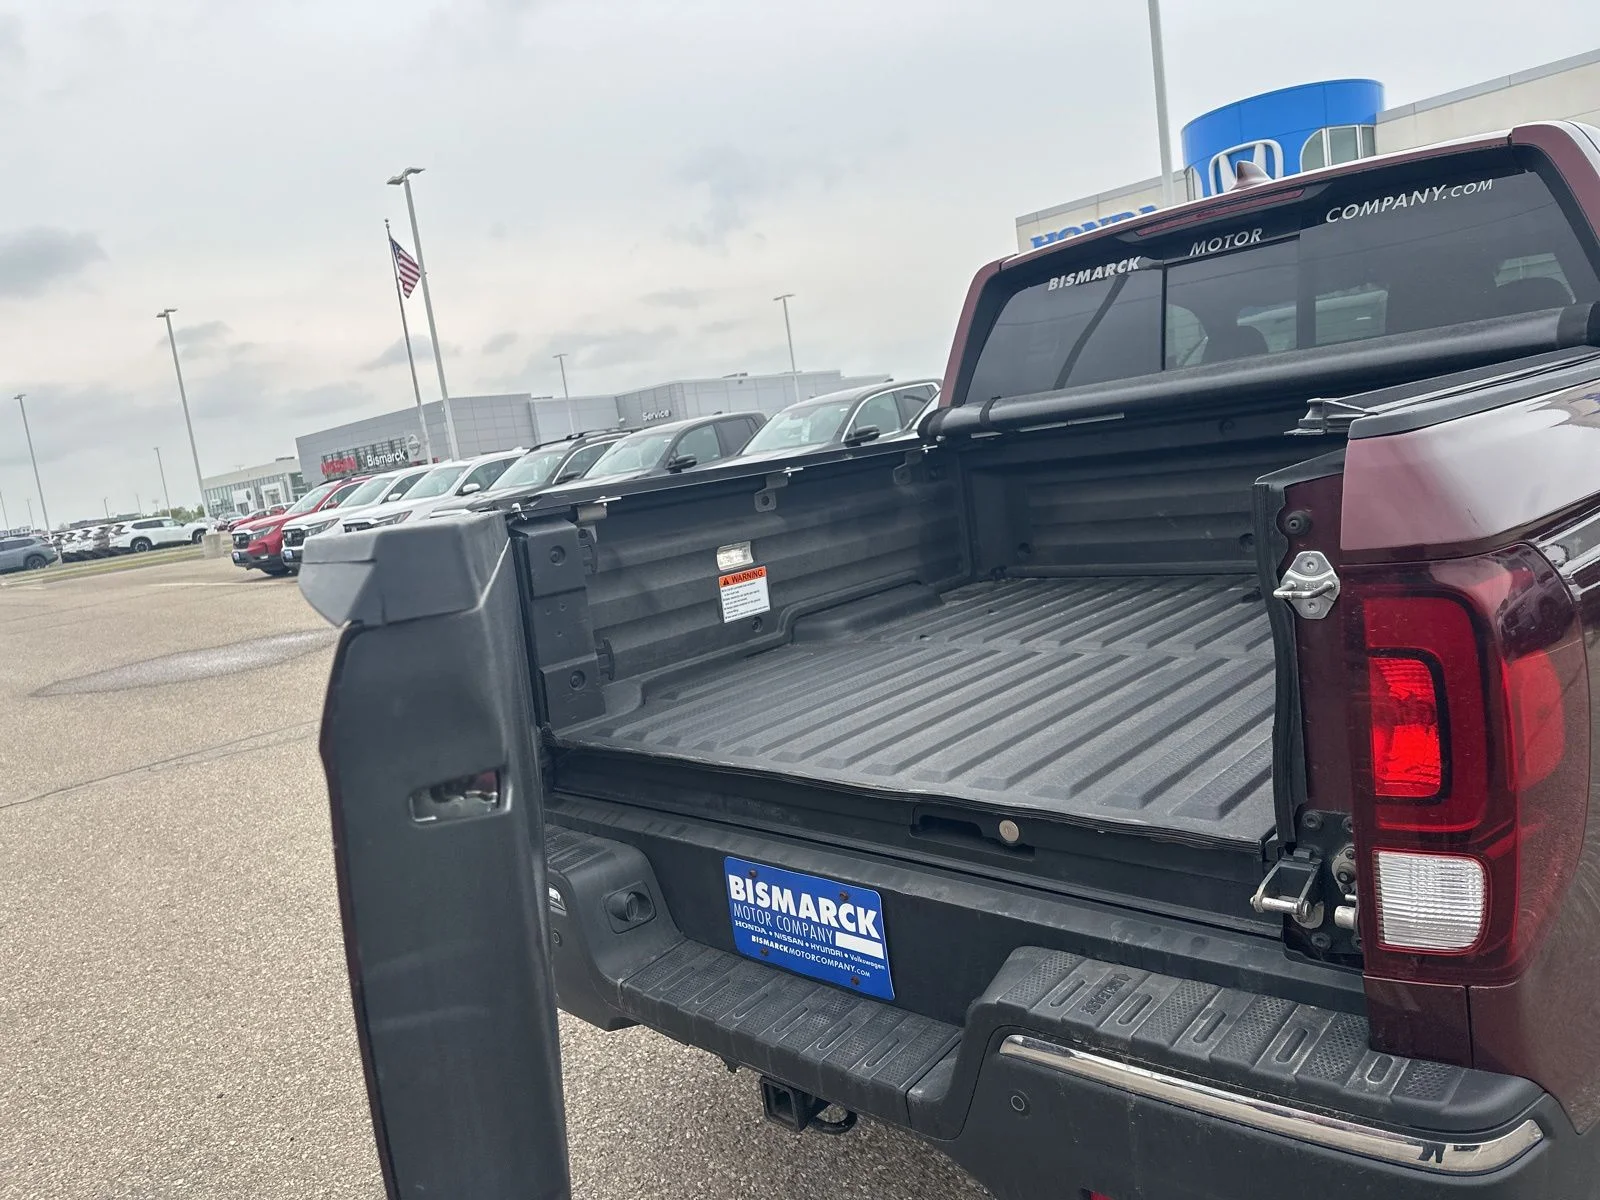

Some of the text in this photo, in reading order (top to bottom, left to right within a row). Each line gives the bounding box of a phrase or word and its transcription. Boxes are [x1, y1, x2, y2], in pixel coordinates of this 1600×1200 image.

[1048, 178, 1493, 291] BISMARCK MOTOR COMPANY.COM
[642, 409, 671, 421] Service
[366, 449, 406, 467] Bismarck
[731, 569, 763, 583] WARNING
[728, 874, 881, 939] BISMARCK
[733, 902, 833, 945] MOTOR COMPANY
[735, 919, 767, 935] HONDA
[774, 931, 804, 946] NISSAN
[810, 942, 843, 957] HYUNDAI
[751, 934, 871, 978] BISMARCKMOTORCOMPANY.COM
